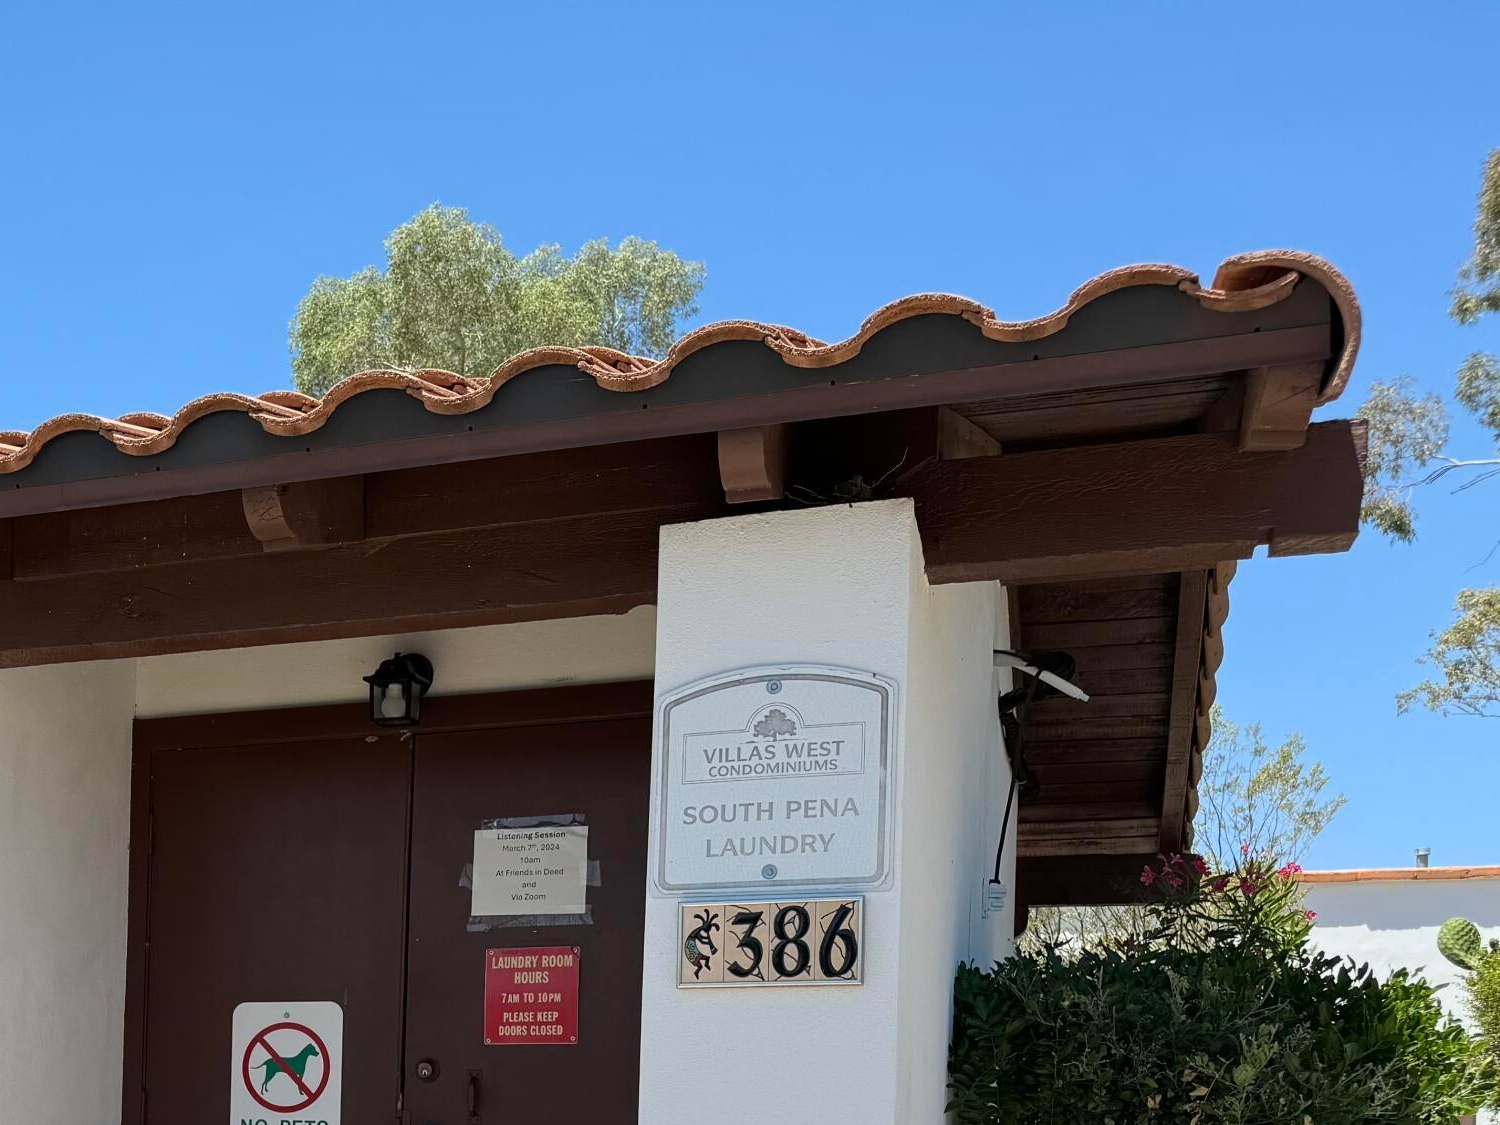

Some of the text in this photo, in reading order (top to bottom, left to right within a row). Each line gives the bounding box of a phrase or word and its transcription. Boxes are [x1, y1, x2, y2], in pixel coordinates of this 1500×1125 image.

[703, 740, 845, 764] VILLAS WEST
[708, 758, 838, 778] CONDOMINIUMS
[683, 797, 860, 825] SOUTH PENA
[497, 831, 566, 841] Listening Session
[540, 843, 560, 851] 2024
[705, 833, 836, 858] LAUNDRY
[520, 856, 541, 864] 10am
[496, 868, 564, 877] At Friends in Deed
[522, 881, 537, 889] and
[511, 893, 546, 901] Via Zoom
[727, 904, 858, 979] 386
[491, 954, 573, 969] LAUNDRY ROOM
[514, 971, 549, 984] HOURS
[523, 993, 534, 1003] TO
[503, 1011, 559, 1022] PLEASE KEEP
[498, 1025, 563, 1036] DOORS CLOSED
